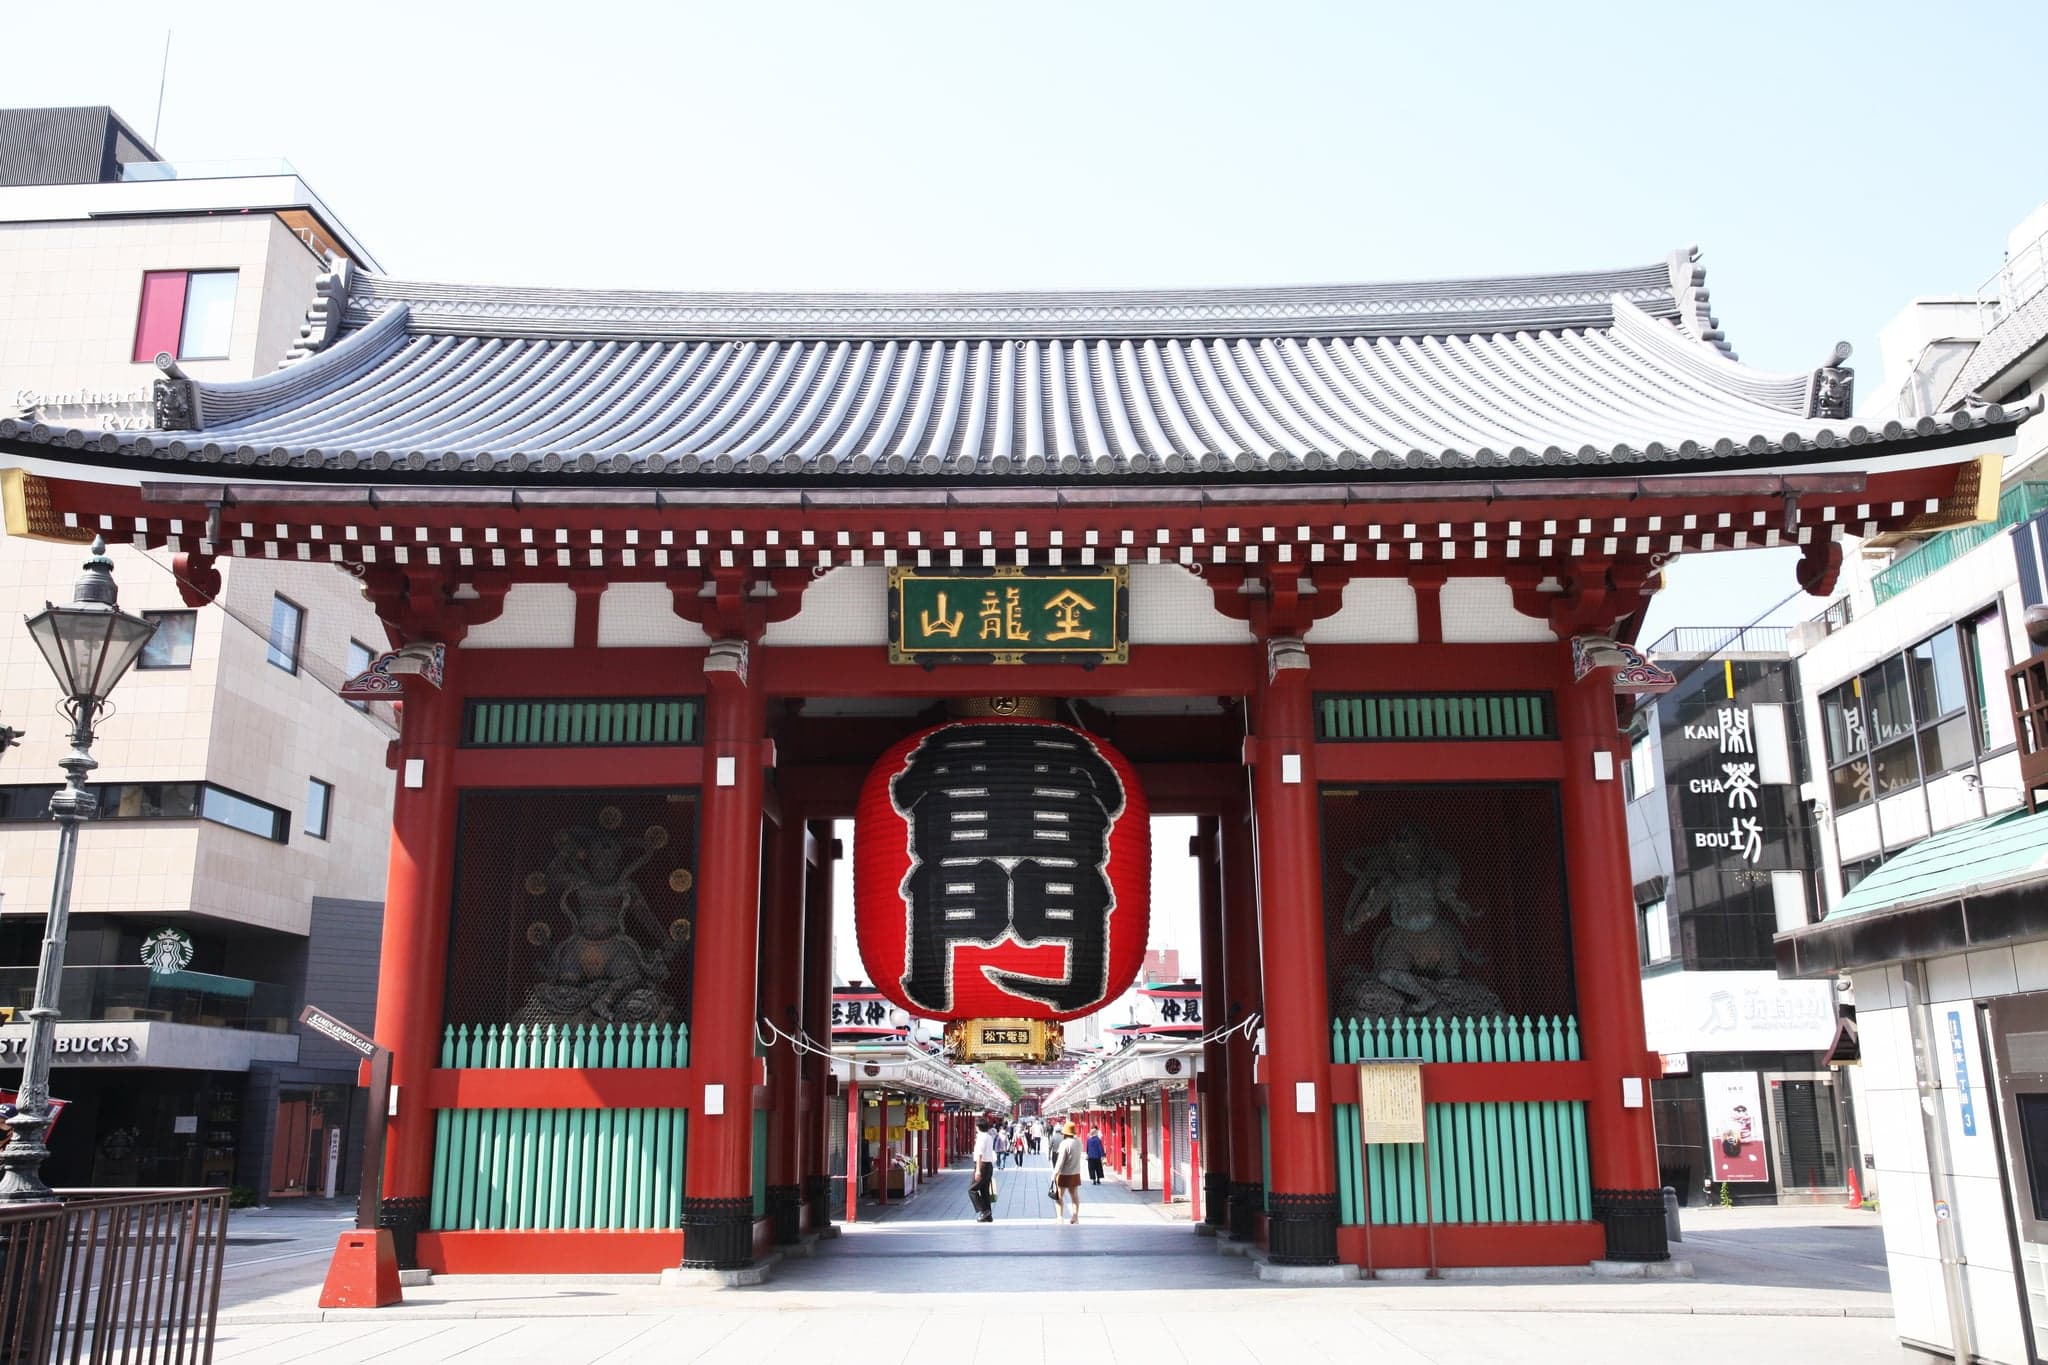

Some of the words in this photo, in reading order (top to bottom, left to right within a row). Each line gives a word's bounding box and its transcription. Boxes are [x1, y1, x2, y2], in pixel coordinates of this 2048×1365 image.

[1684, 725, 1719, 739] KAN
[1689, 779, 1724, 793] CHA
[1695, 832, 1729, 848] BOU
[888, 722, 1127, 1013] 雷門
[985, 1030, 1028, 1043] 松下電器
[0, 1037, 130, 1053] STBUCKS
[355, 1038, 374, 1052] GATE
[1964, 1113, 1971, 1128] 3
